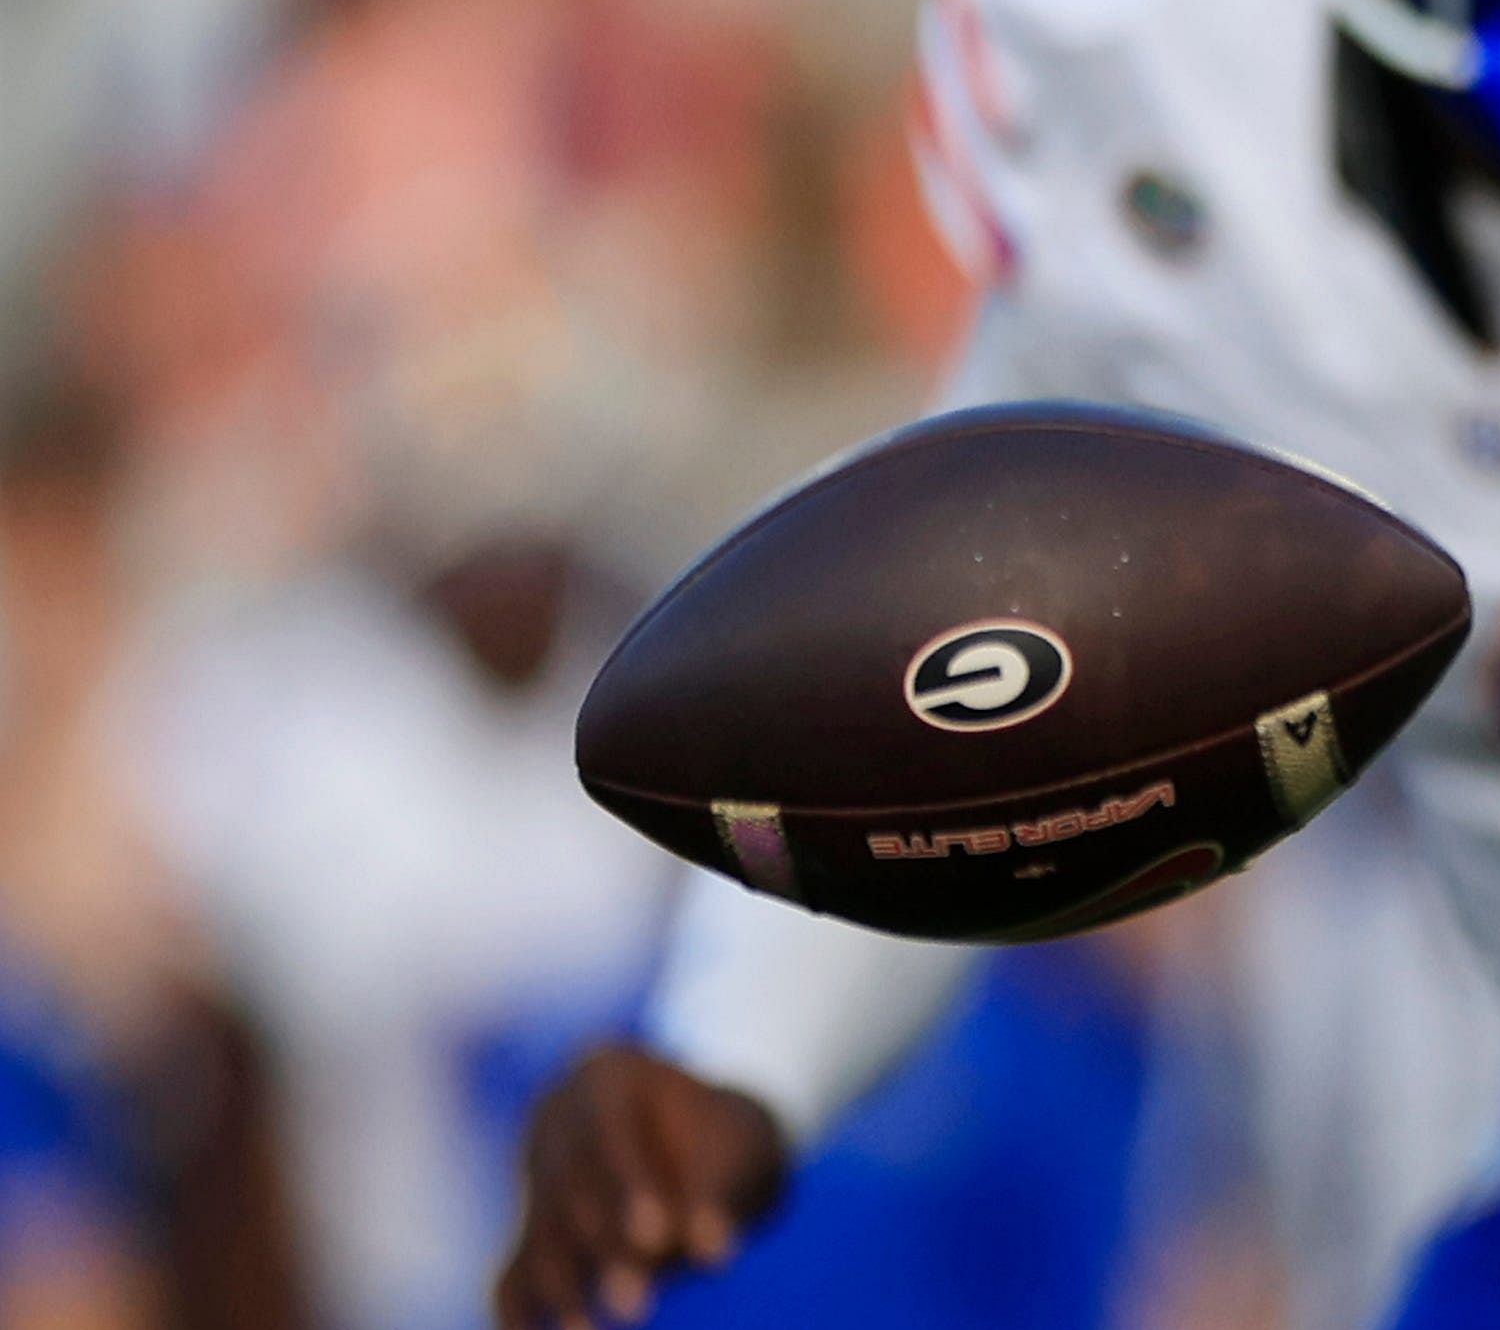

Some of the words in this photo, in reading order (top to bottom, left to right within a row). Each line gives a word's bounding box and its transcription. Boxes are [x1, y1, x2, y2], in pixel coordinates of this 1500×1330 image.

[908, 623, 1069, 728] G
[866, 825, 1011, 860] ELITE
[1012, 781, 1176, 847] VAPOR
